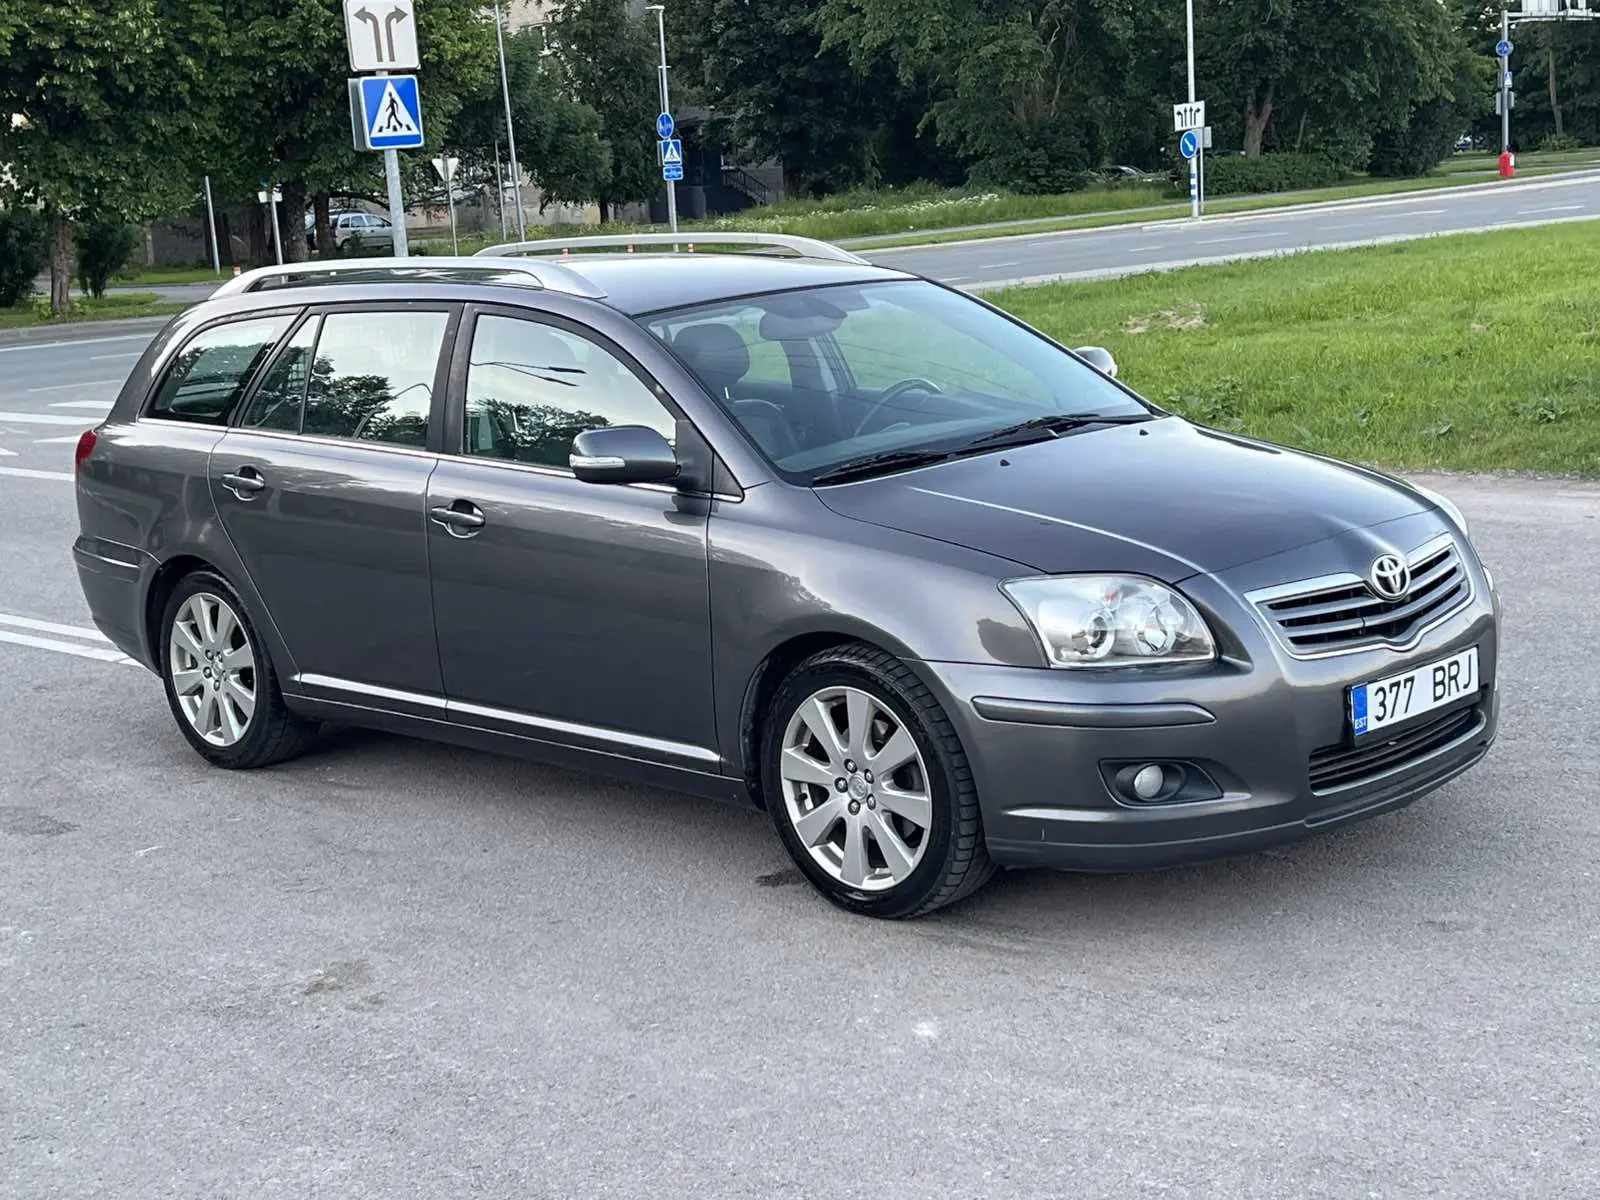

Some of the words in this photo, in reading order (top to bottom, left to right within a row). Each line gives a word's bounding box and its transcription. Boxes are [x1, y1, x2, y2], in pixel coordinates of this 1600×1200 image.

[1374, 675, 1415, 722] 377
[1432, 654, 1472, 702] BRJ
[1354, 717, 1367, 730] EST
